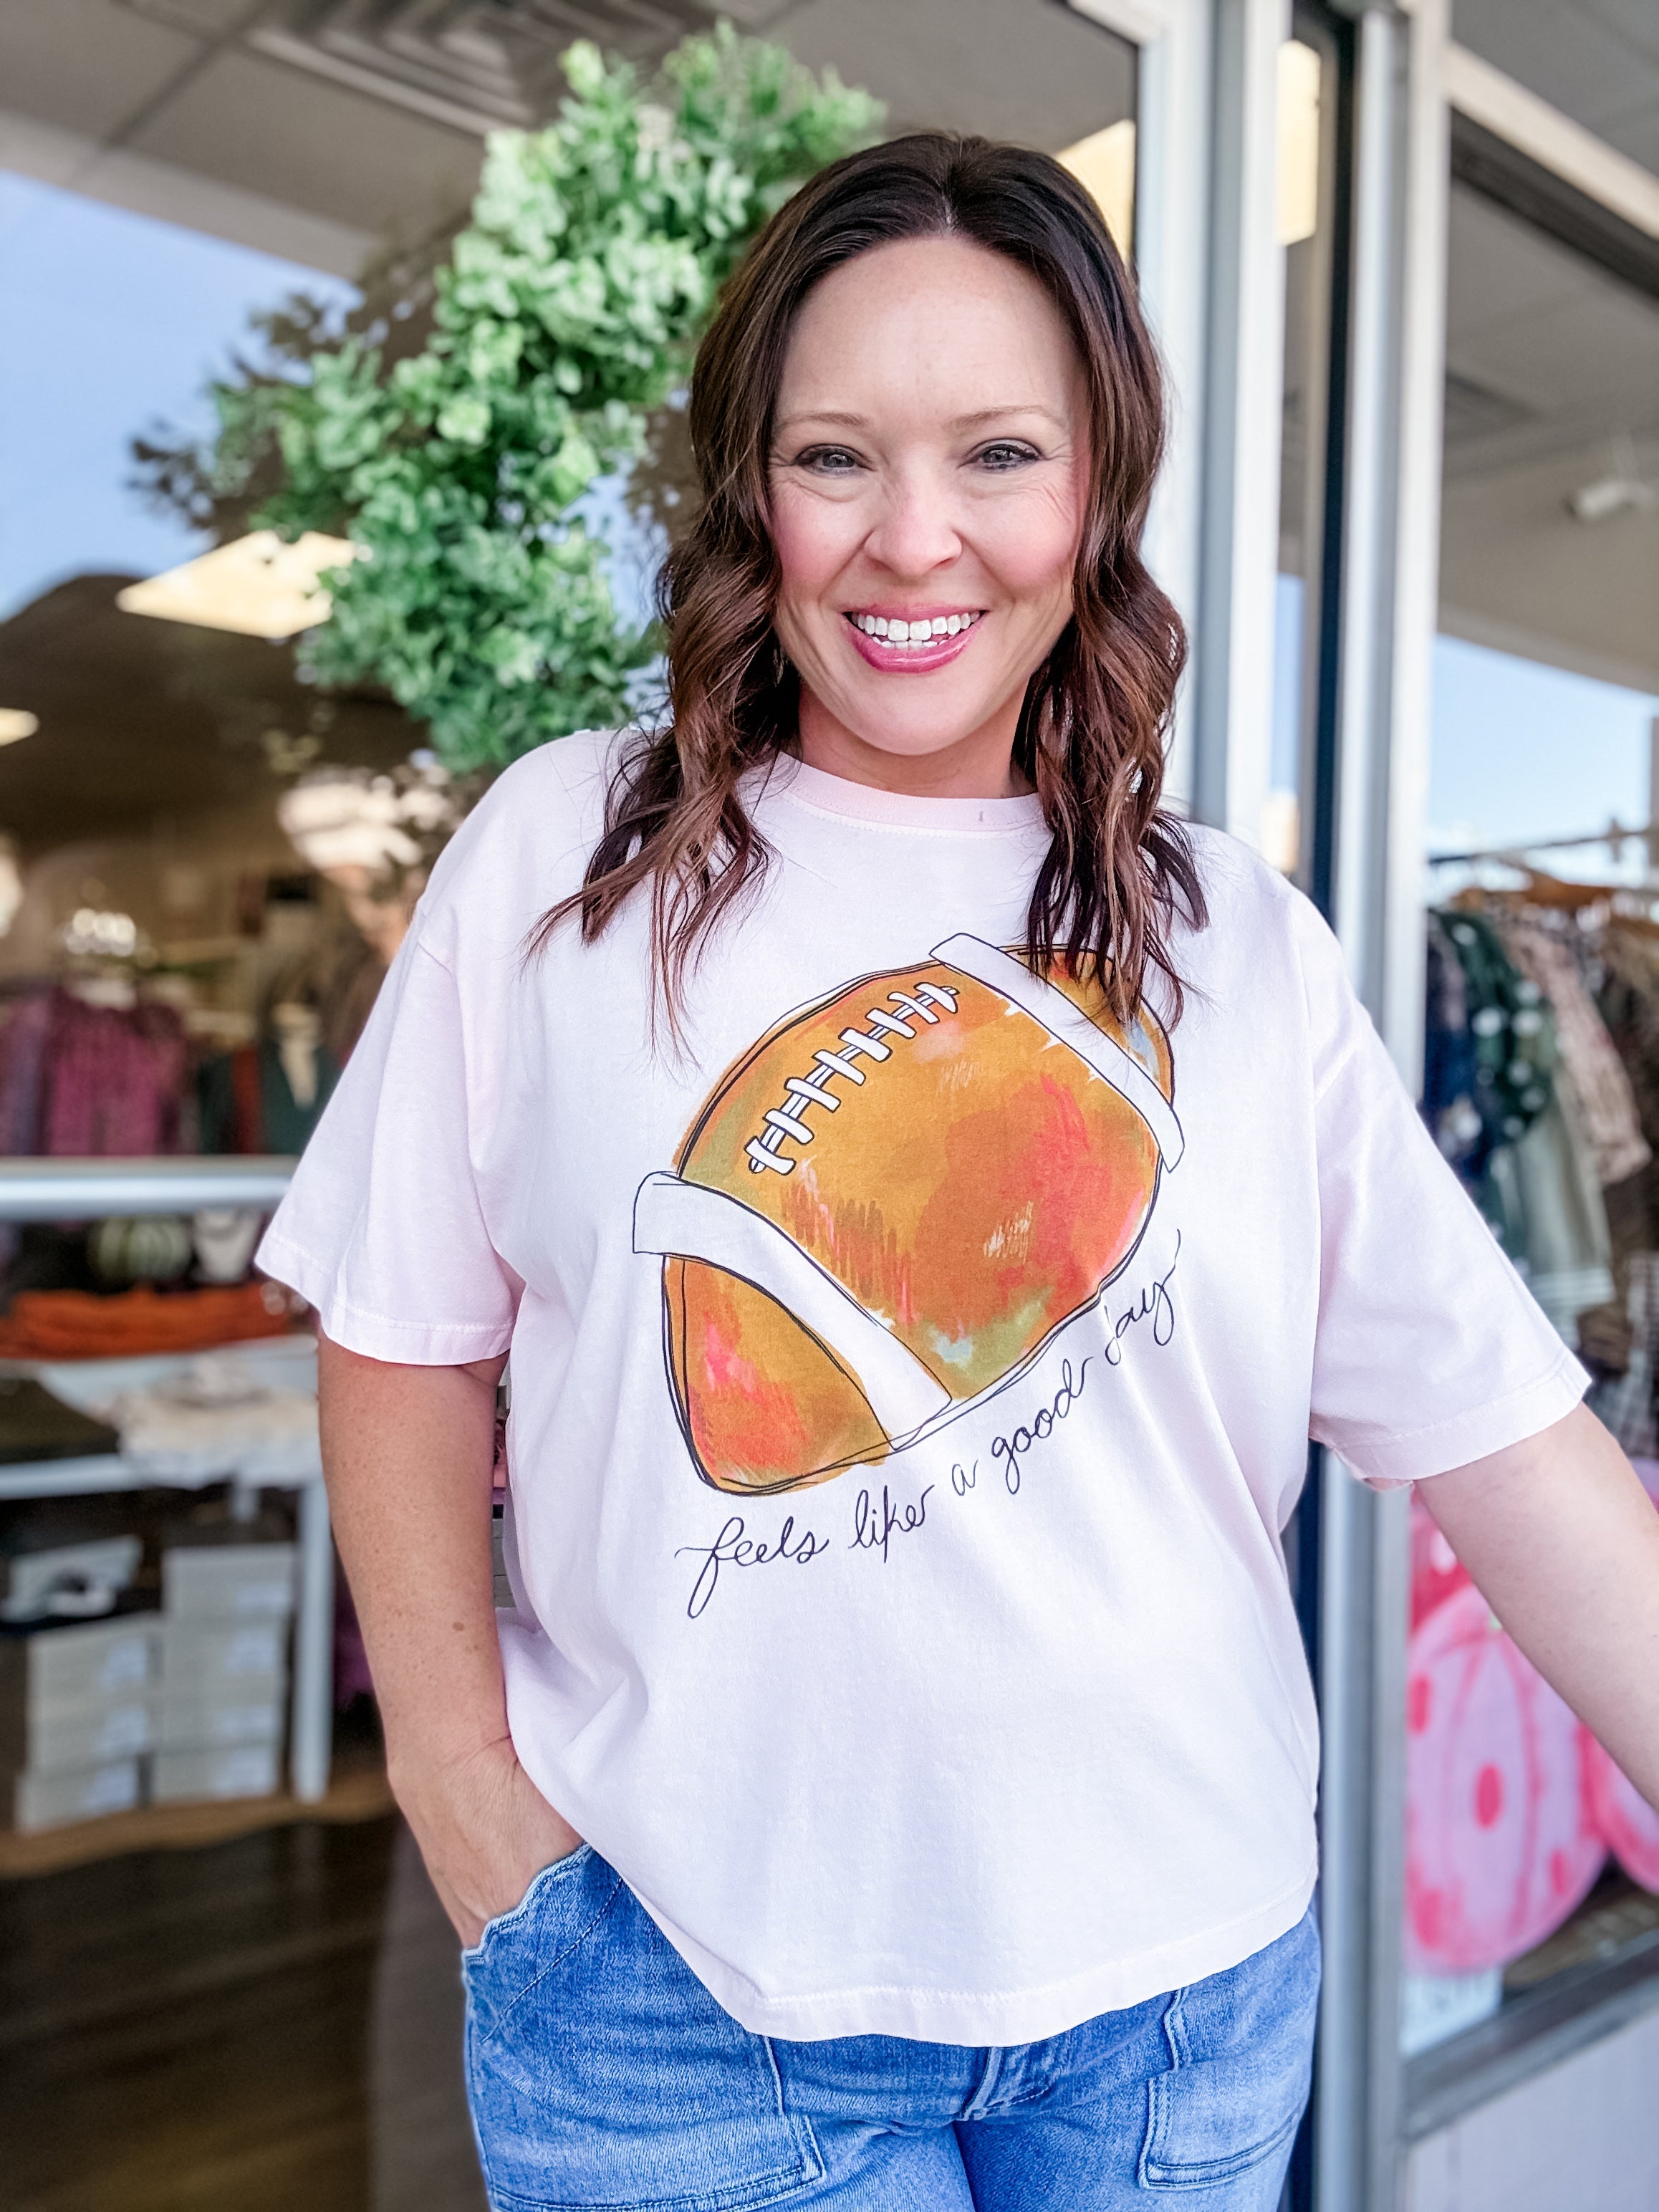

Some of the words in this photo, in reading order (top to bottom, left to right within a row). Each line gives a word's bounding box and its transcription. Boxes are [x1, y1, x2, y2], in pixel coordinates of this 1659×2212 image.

[674, 1514, 830, 1620] feels
[847, 1484, 936, 1564] like
[951, 1459, 979, 1496] a
[991, 1355, 1095, 1496] good
